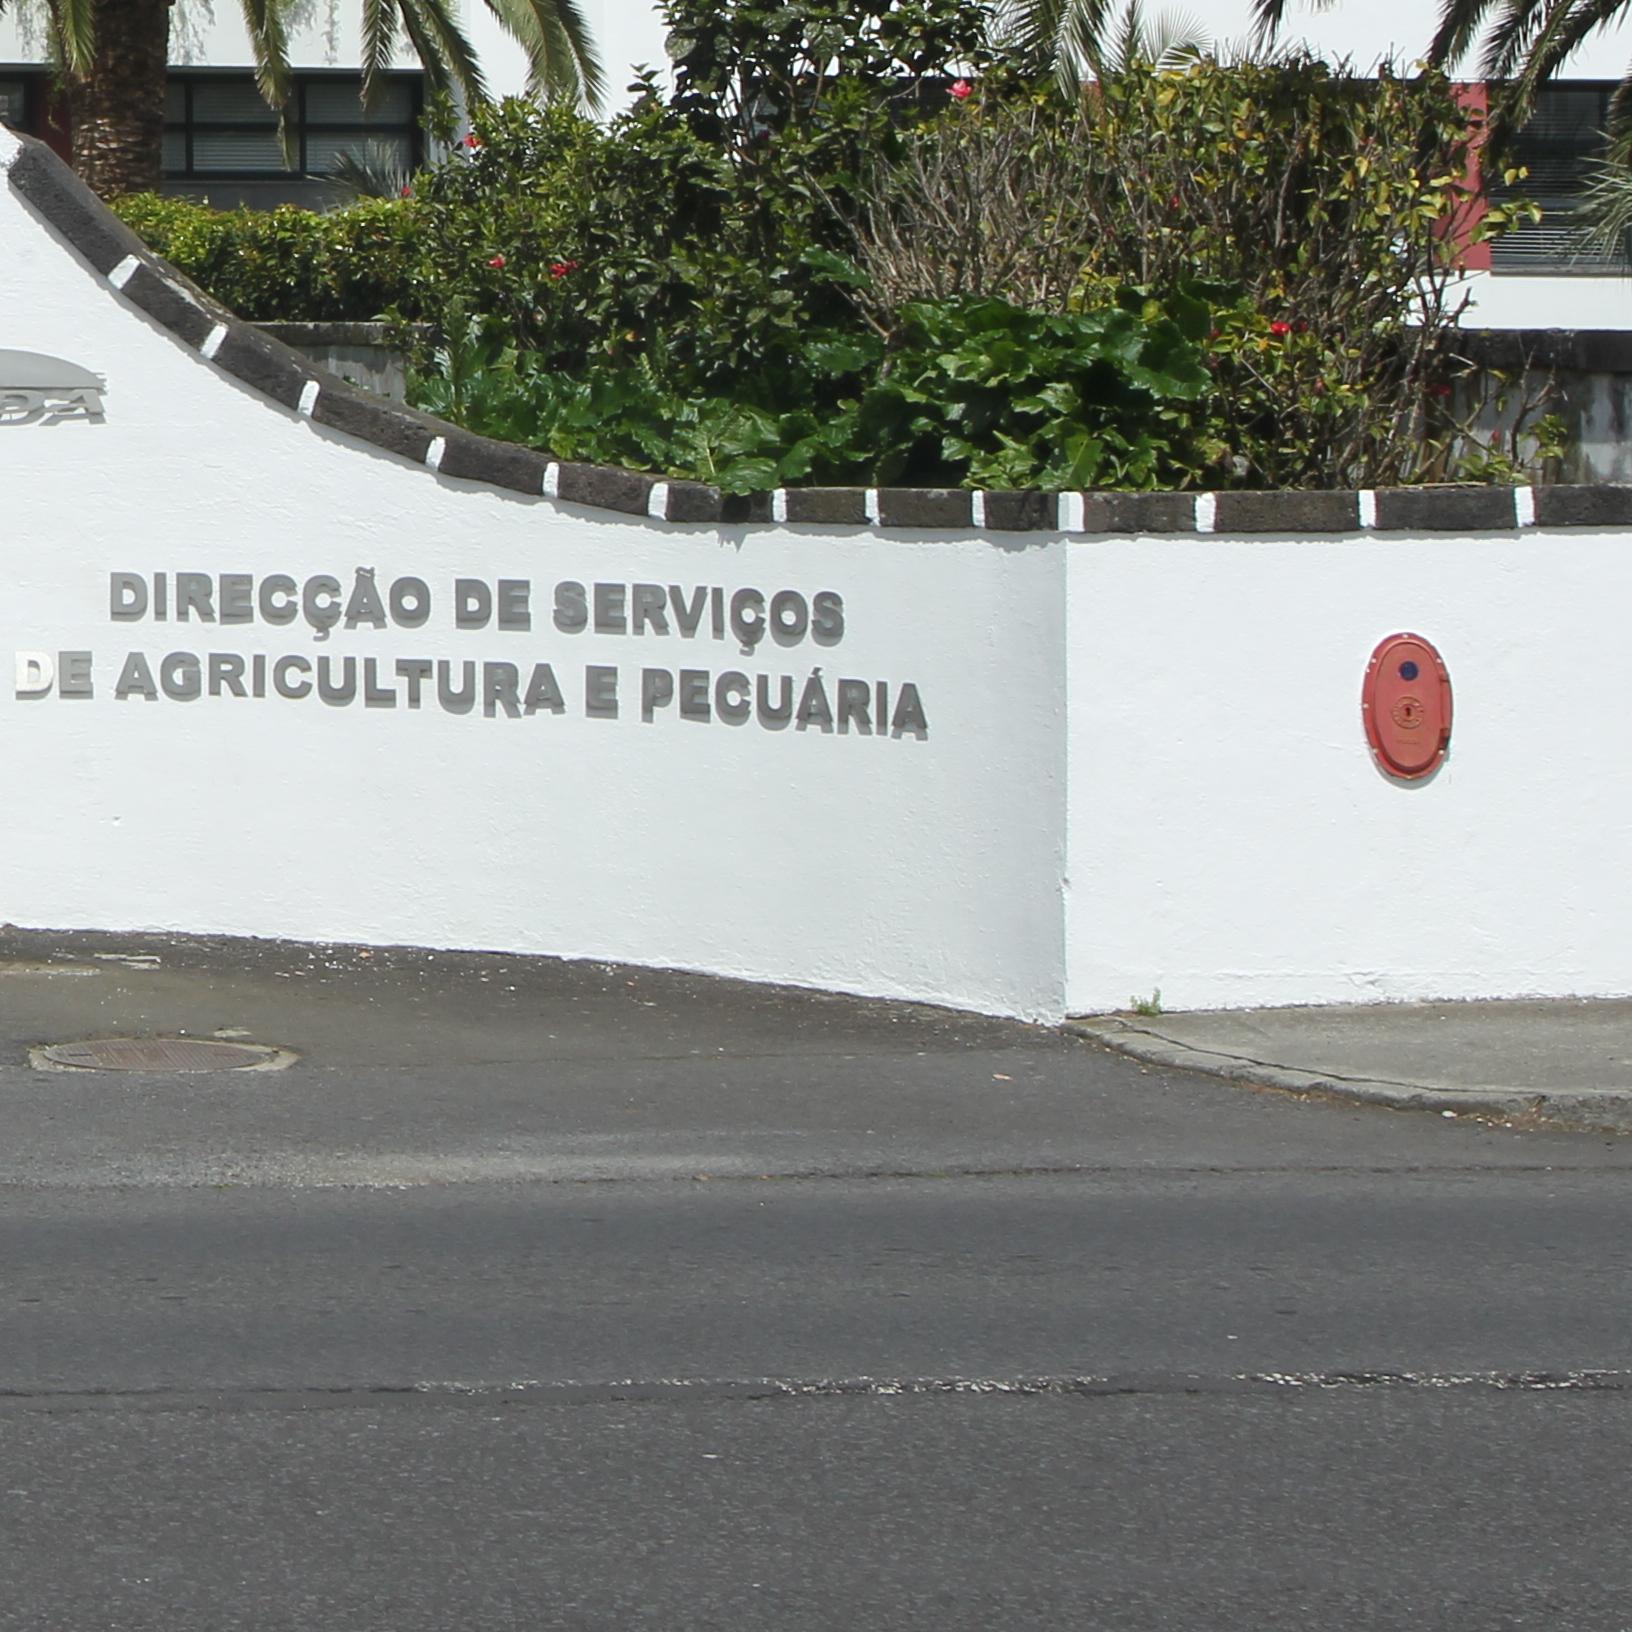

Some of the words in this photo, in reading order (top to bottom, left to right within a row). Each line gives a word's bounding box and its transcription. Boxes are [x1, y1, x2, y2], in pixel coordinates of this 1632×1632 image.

[110, 566, 431, 638] DIRECÇÃO
[454, 577, 531, 629] DE
[552, 580, 844, 653] SERVIÇOS
[15, 651, 94, 699] DE
[114, 651, 566, 717] AGRICULTURA
[585, 664, 619, 718] E
[641, 667, 929, 738] PECUÁRIA
